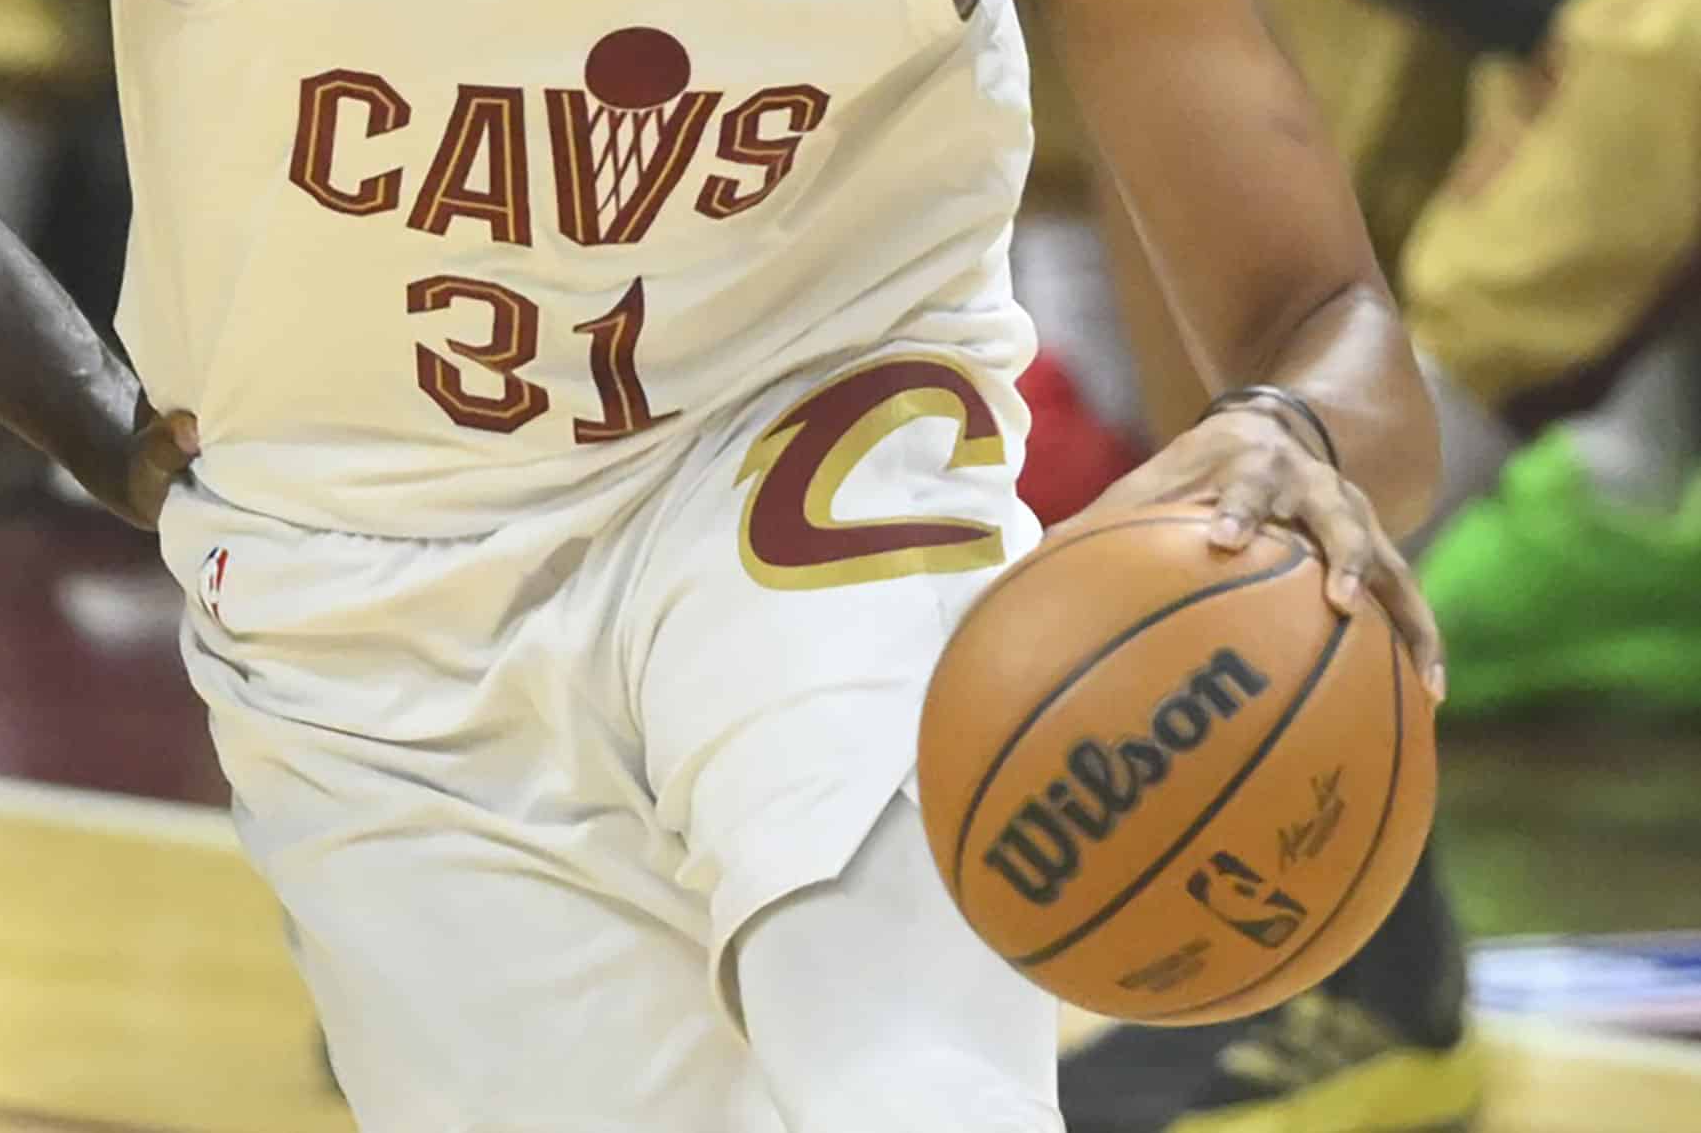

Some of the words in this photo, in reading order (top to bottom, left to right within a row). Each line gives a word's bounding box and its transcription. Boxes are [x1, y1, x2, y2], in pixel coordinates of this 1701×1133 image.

[288, 57, 832, 248] CAVS
[406, 273, 683, 445] 31
[734, 351, 1006, 591] C
[983, 647, 1272, 907] Wilson
